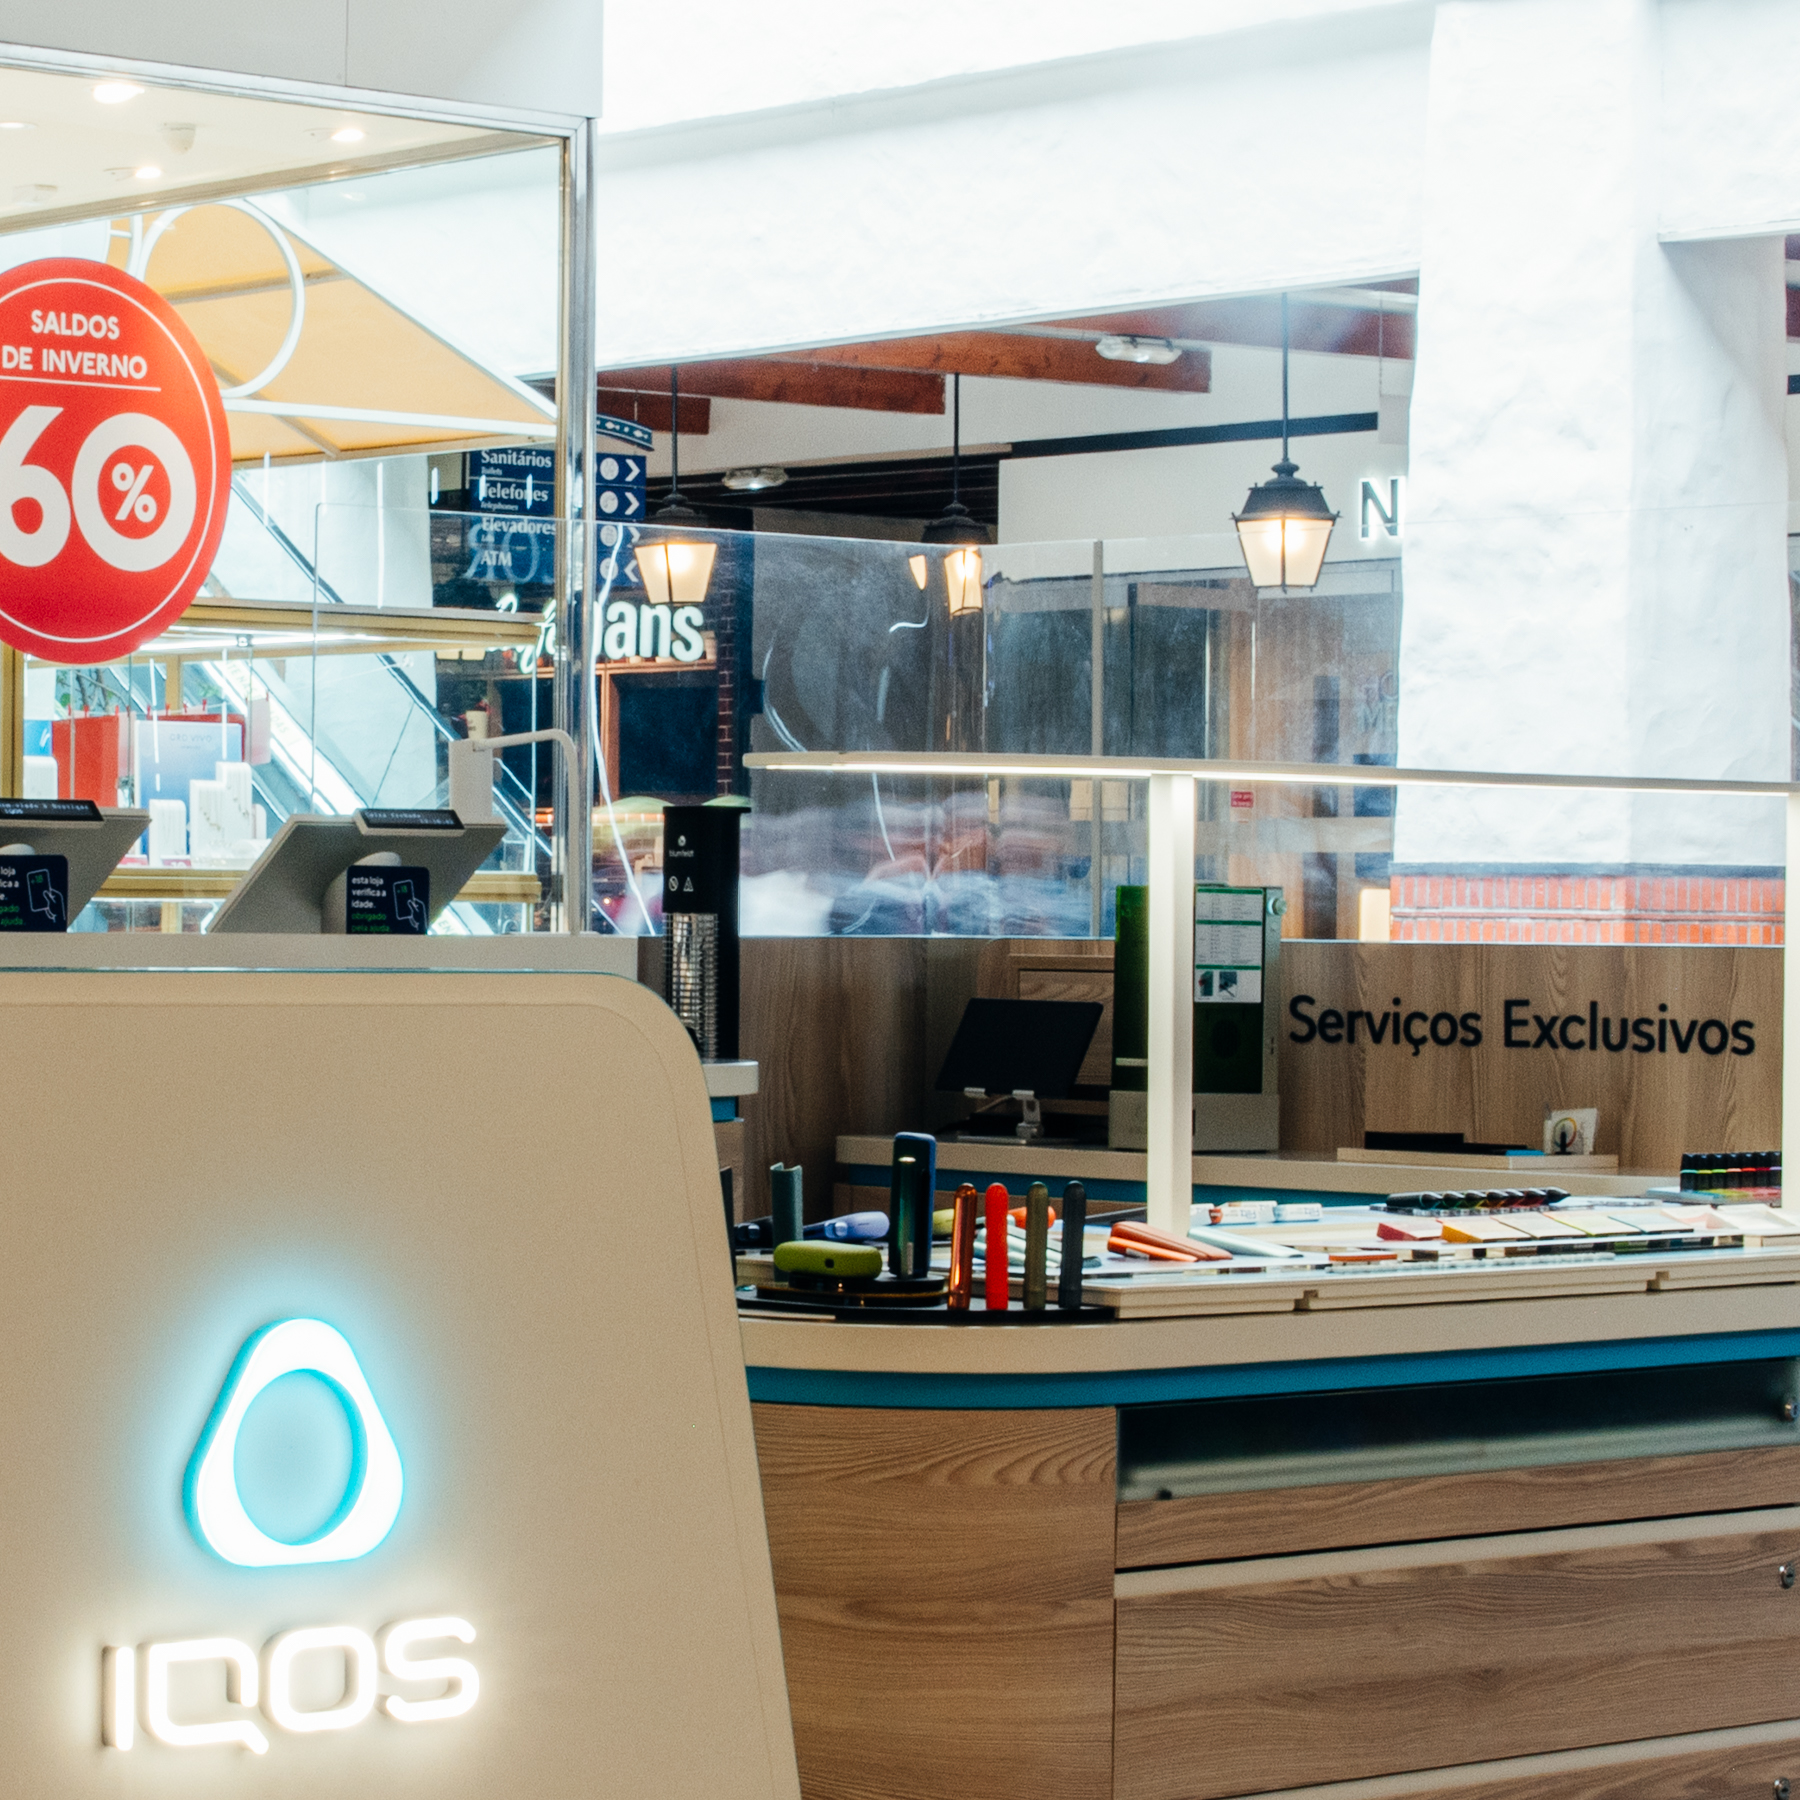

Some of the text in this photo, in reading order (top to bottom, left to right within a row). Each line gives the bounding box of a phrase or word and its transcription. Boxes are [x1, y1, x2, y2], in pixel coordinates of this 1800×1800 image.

[31, 310, 120, 340] SALDOS
[2, 345, 147, 379] DE INVERNO
[481, 449, 552, 468] Sanitários
[481, 551, 512, 566] ATM
[593, 600, 704, 662] ans
[190, 733, 212, 743] VIVO
[0, 867, 16, 877] loja
[352, 877, 384, 887] esta loja
[352, 888, 380, 897] verifica
[352, 913, 386, 922] obrigado
[1288, 995, 1756, 1056] Serviços Exclusivos
[102, 1617, 479, 1755] IQOS
